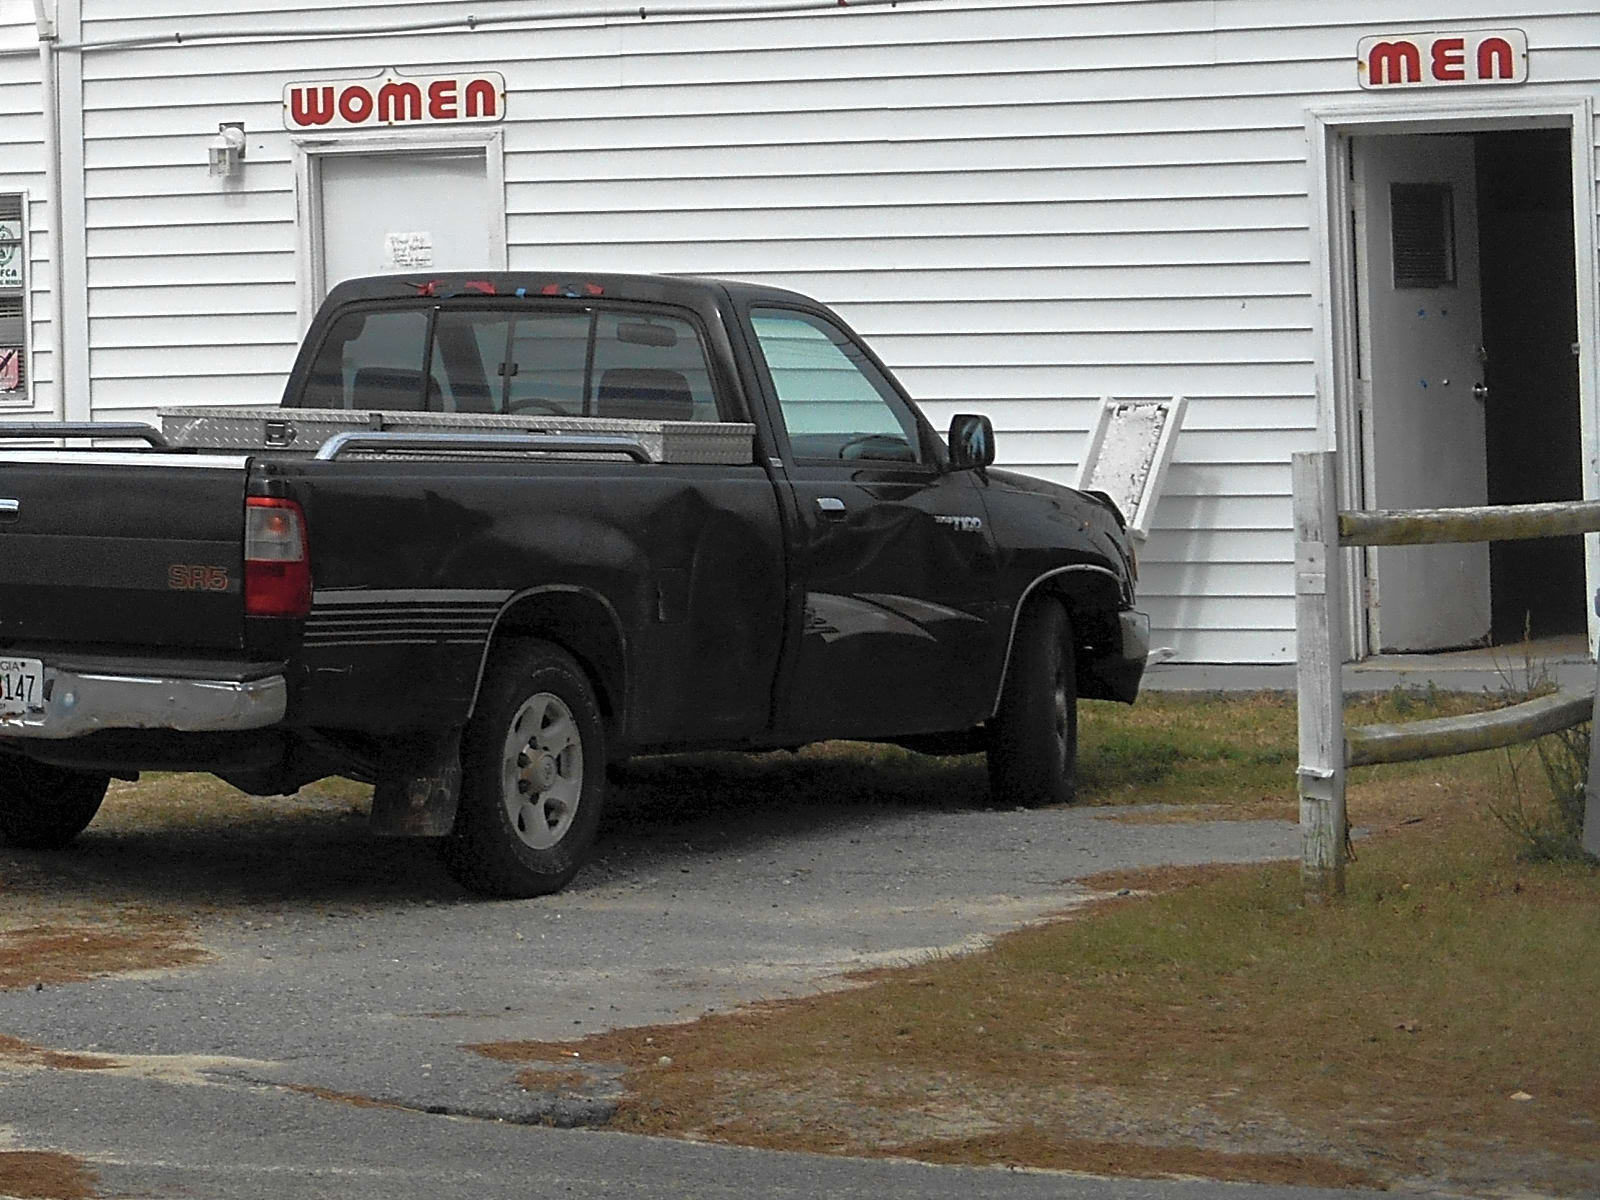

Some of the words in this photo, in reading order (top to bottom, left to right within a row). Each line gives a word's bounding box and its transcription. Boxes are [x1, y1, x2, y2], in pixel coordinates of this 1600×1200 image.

[1369, 38, 1513, 85] MEN
[291, 80, 496, 126] WOMEN
[168, 564, 228, 591] SR5
